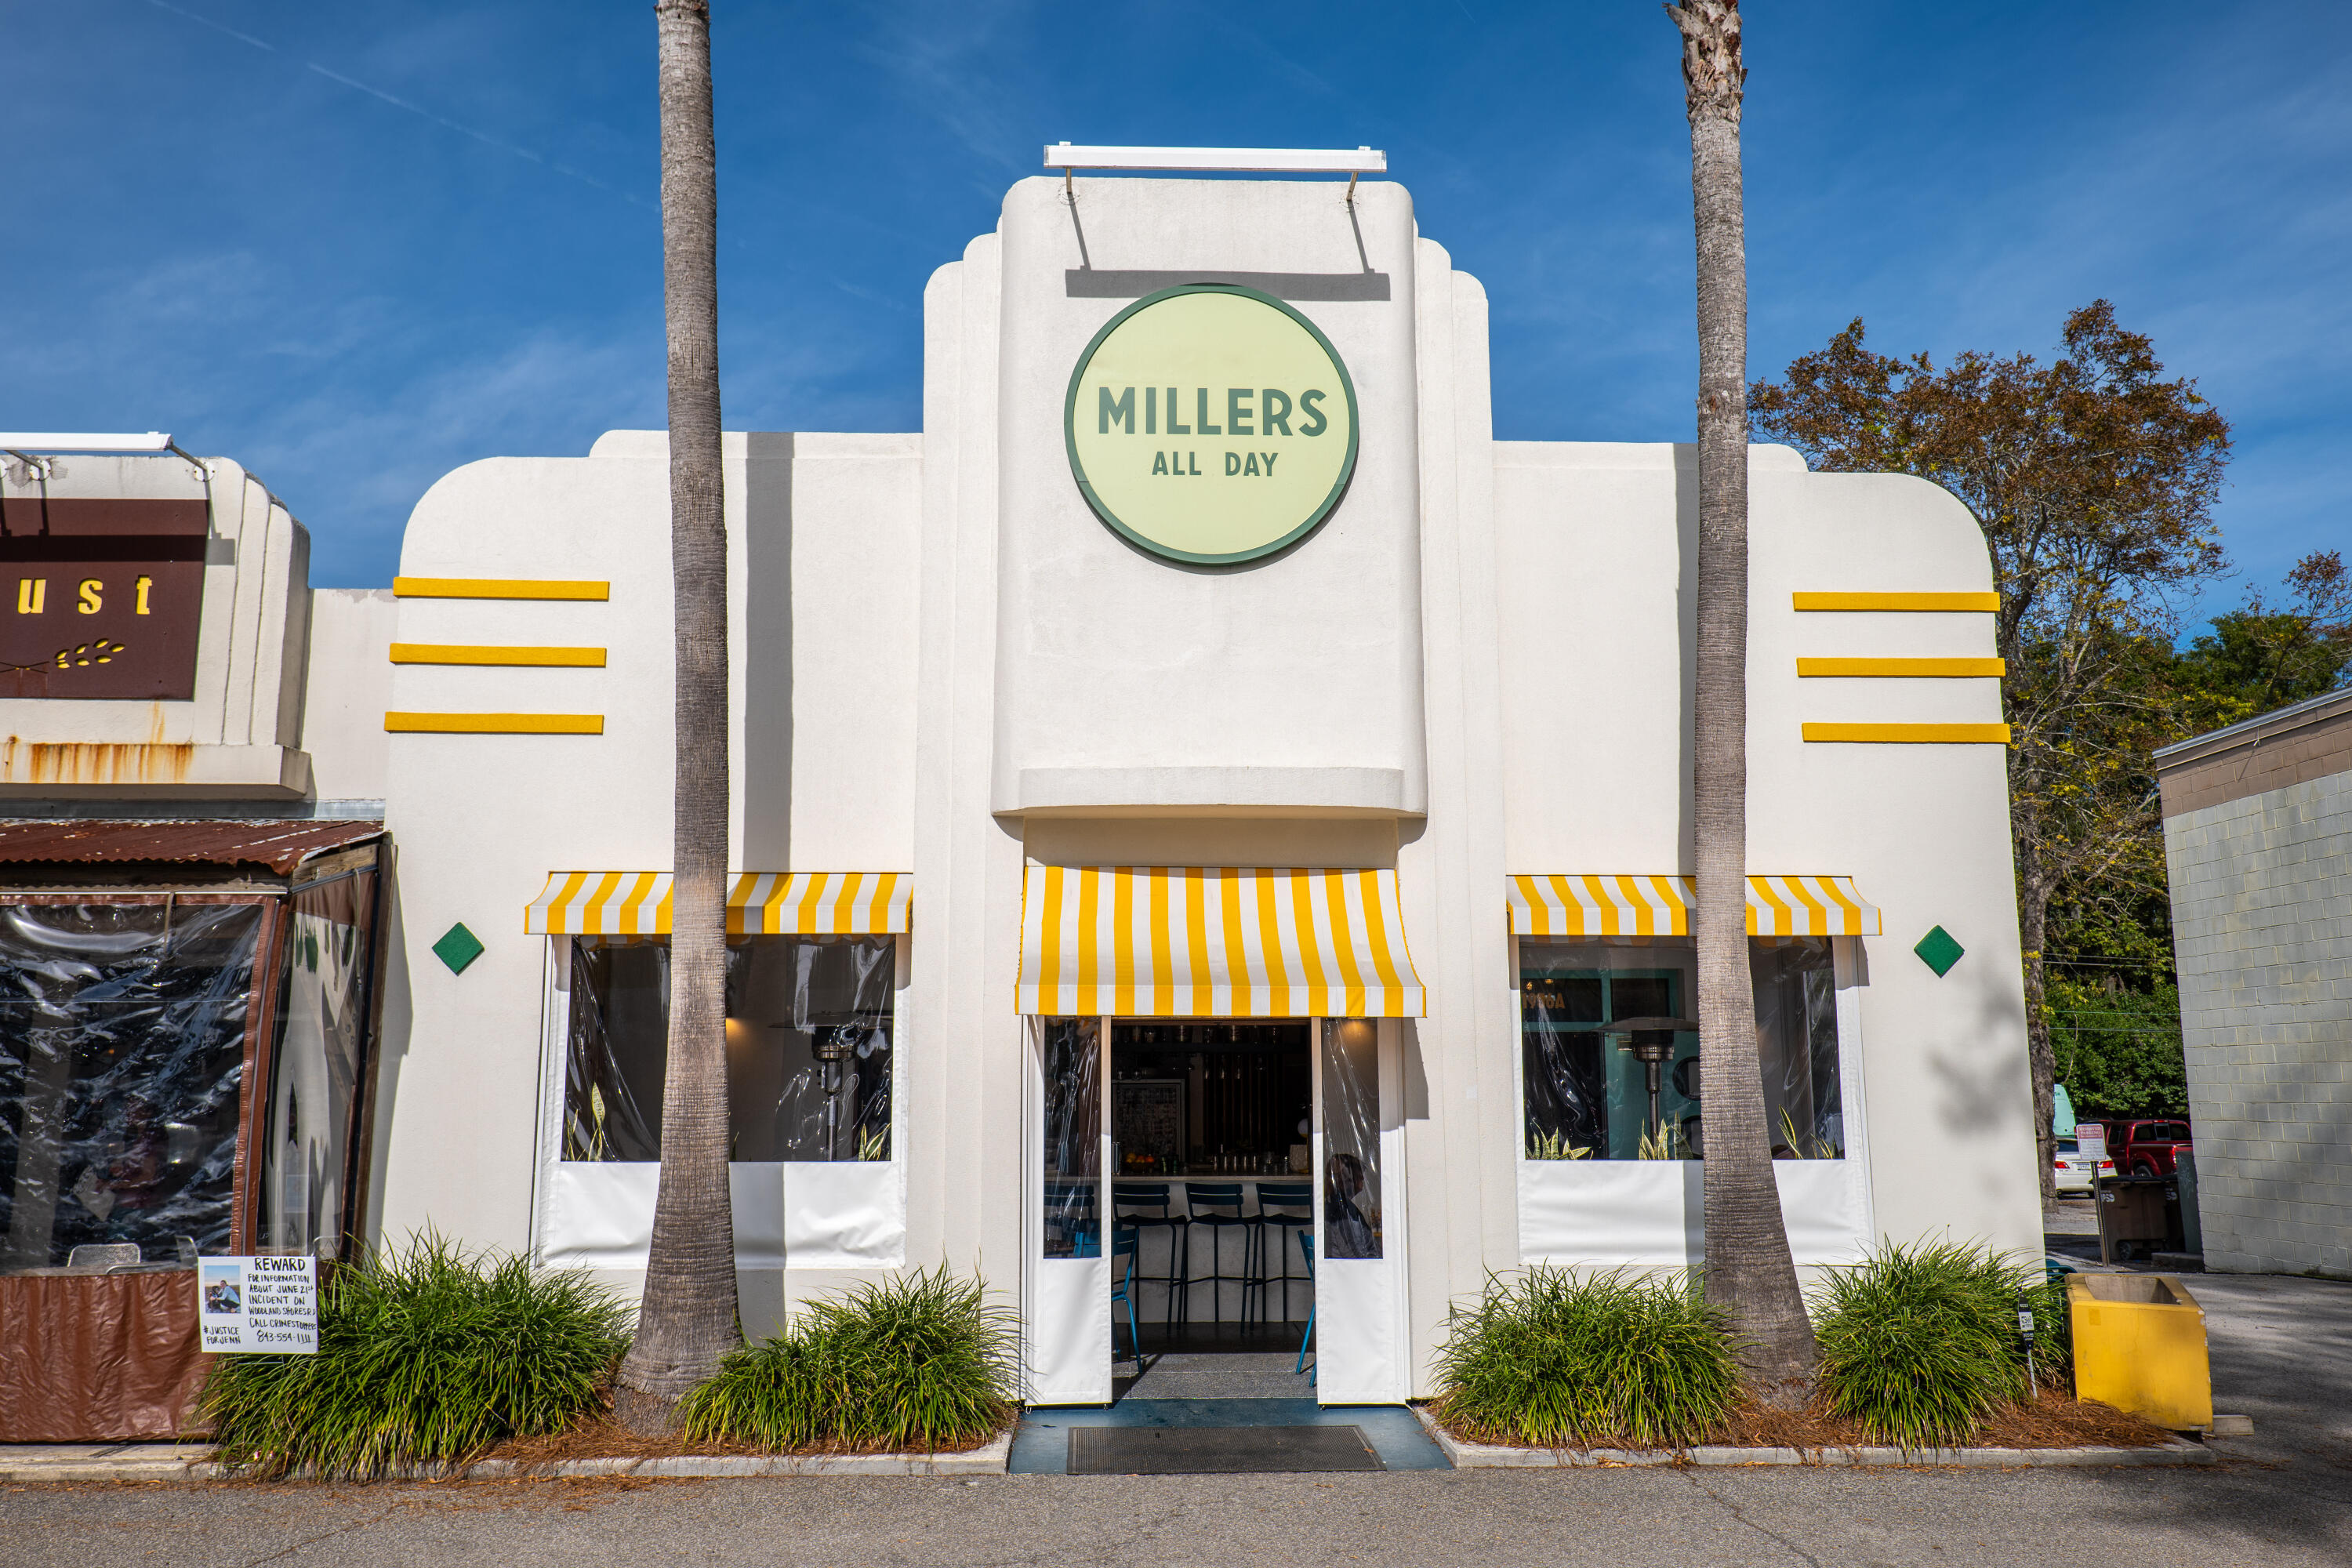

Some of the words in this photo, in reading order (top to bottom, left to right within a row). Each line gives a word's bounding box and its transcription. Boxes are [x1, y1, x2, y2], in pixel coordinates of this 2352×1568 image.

[1098, 387, 1328, 437] MILLERS
[1152, 452, 1202, 475] ALL
[1225, 452, 1279, 476] DAY
[255, 1258, 306, 1272] REWARD
[248, 1273, 259, 1283] FOR
[260, 1274, 310, 1283] INFORMATION
[249, 1284, 273, 1293] ABOUT
[277, 1285, 299, 1294] JUNE
[249, 1294, 289, 1305] INCIDENT
[294, 1295, 305, 1305] ON
[249, 1306, 281, 1316] WOODLAND
[249, 1317, 268, 1328] CALL
[206, 1335, 219, 1345] FOR
[220, 1335, 241, 1345] JENN
[256, 1329, 312, 1344] 843-554-1111
